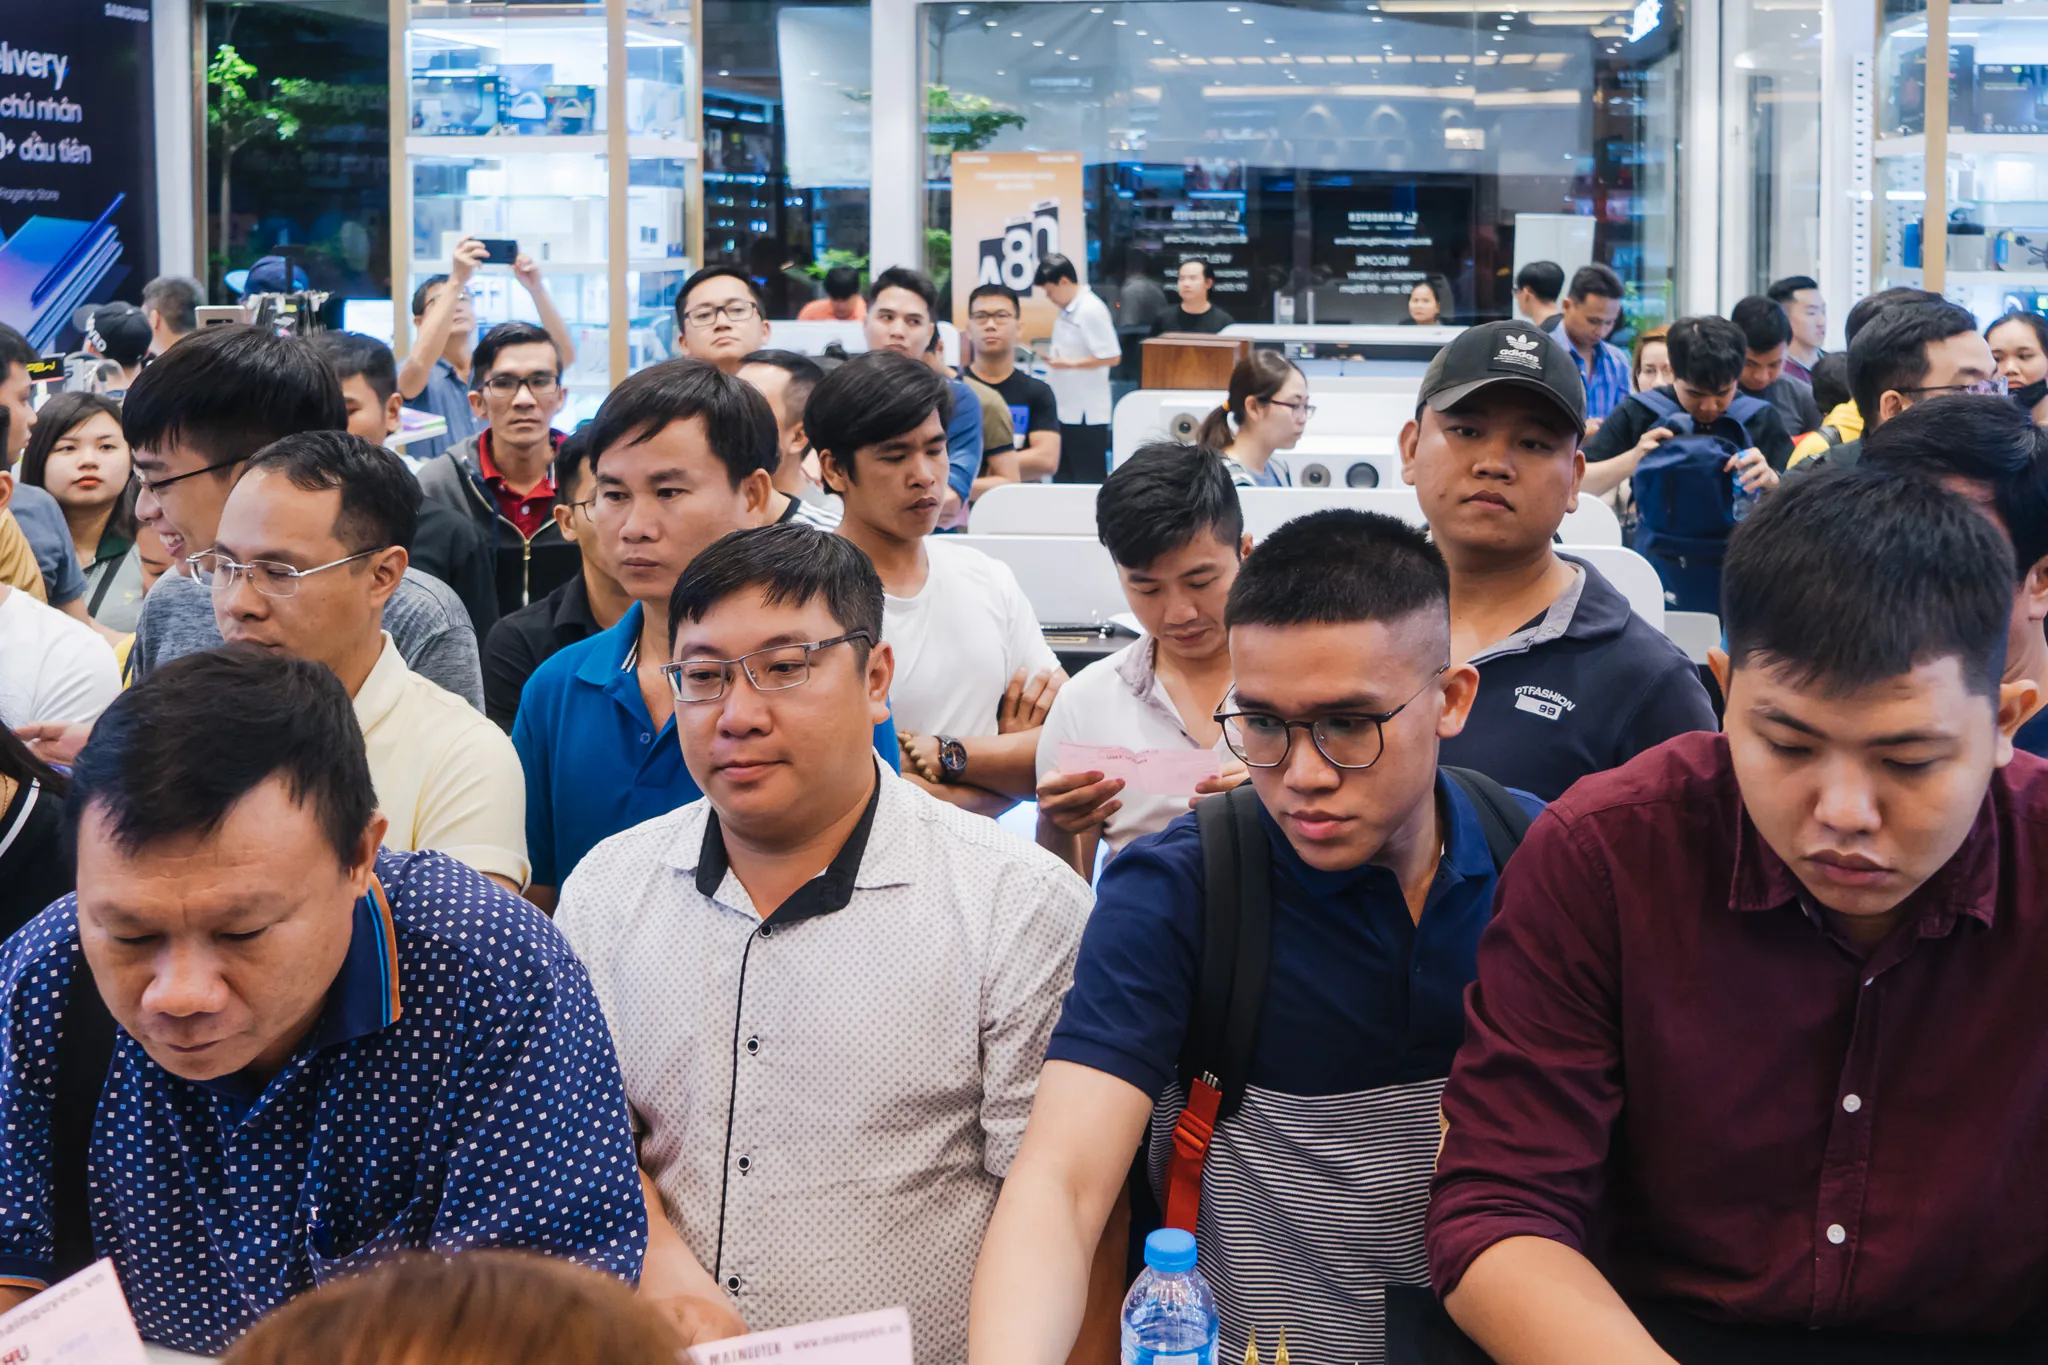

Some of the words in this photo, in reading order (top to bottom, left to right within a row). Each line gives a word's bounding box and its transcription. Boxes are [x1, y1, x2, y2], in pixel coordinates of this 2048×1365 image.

[0, 41, 68, 90] livery
[1499, 348, 1540, 363] adidas
[1538, 704, 1557, 716] 99
